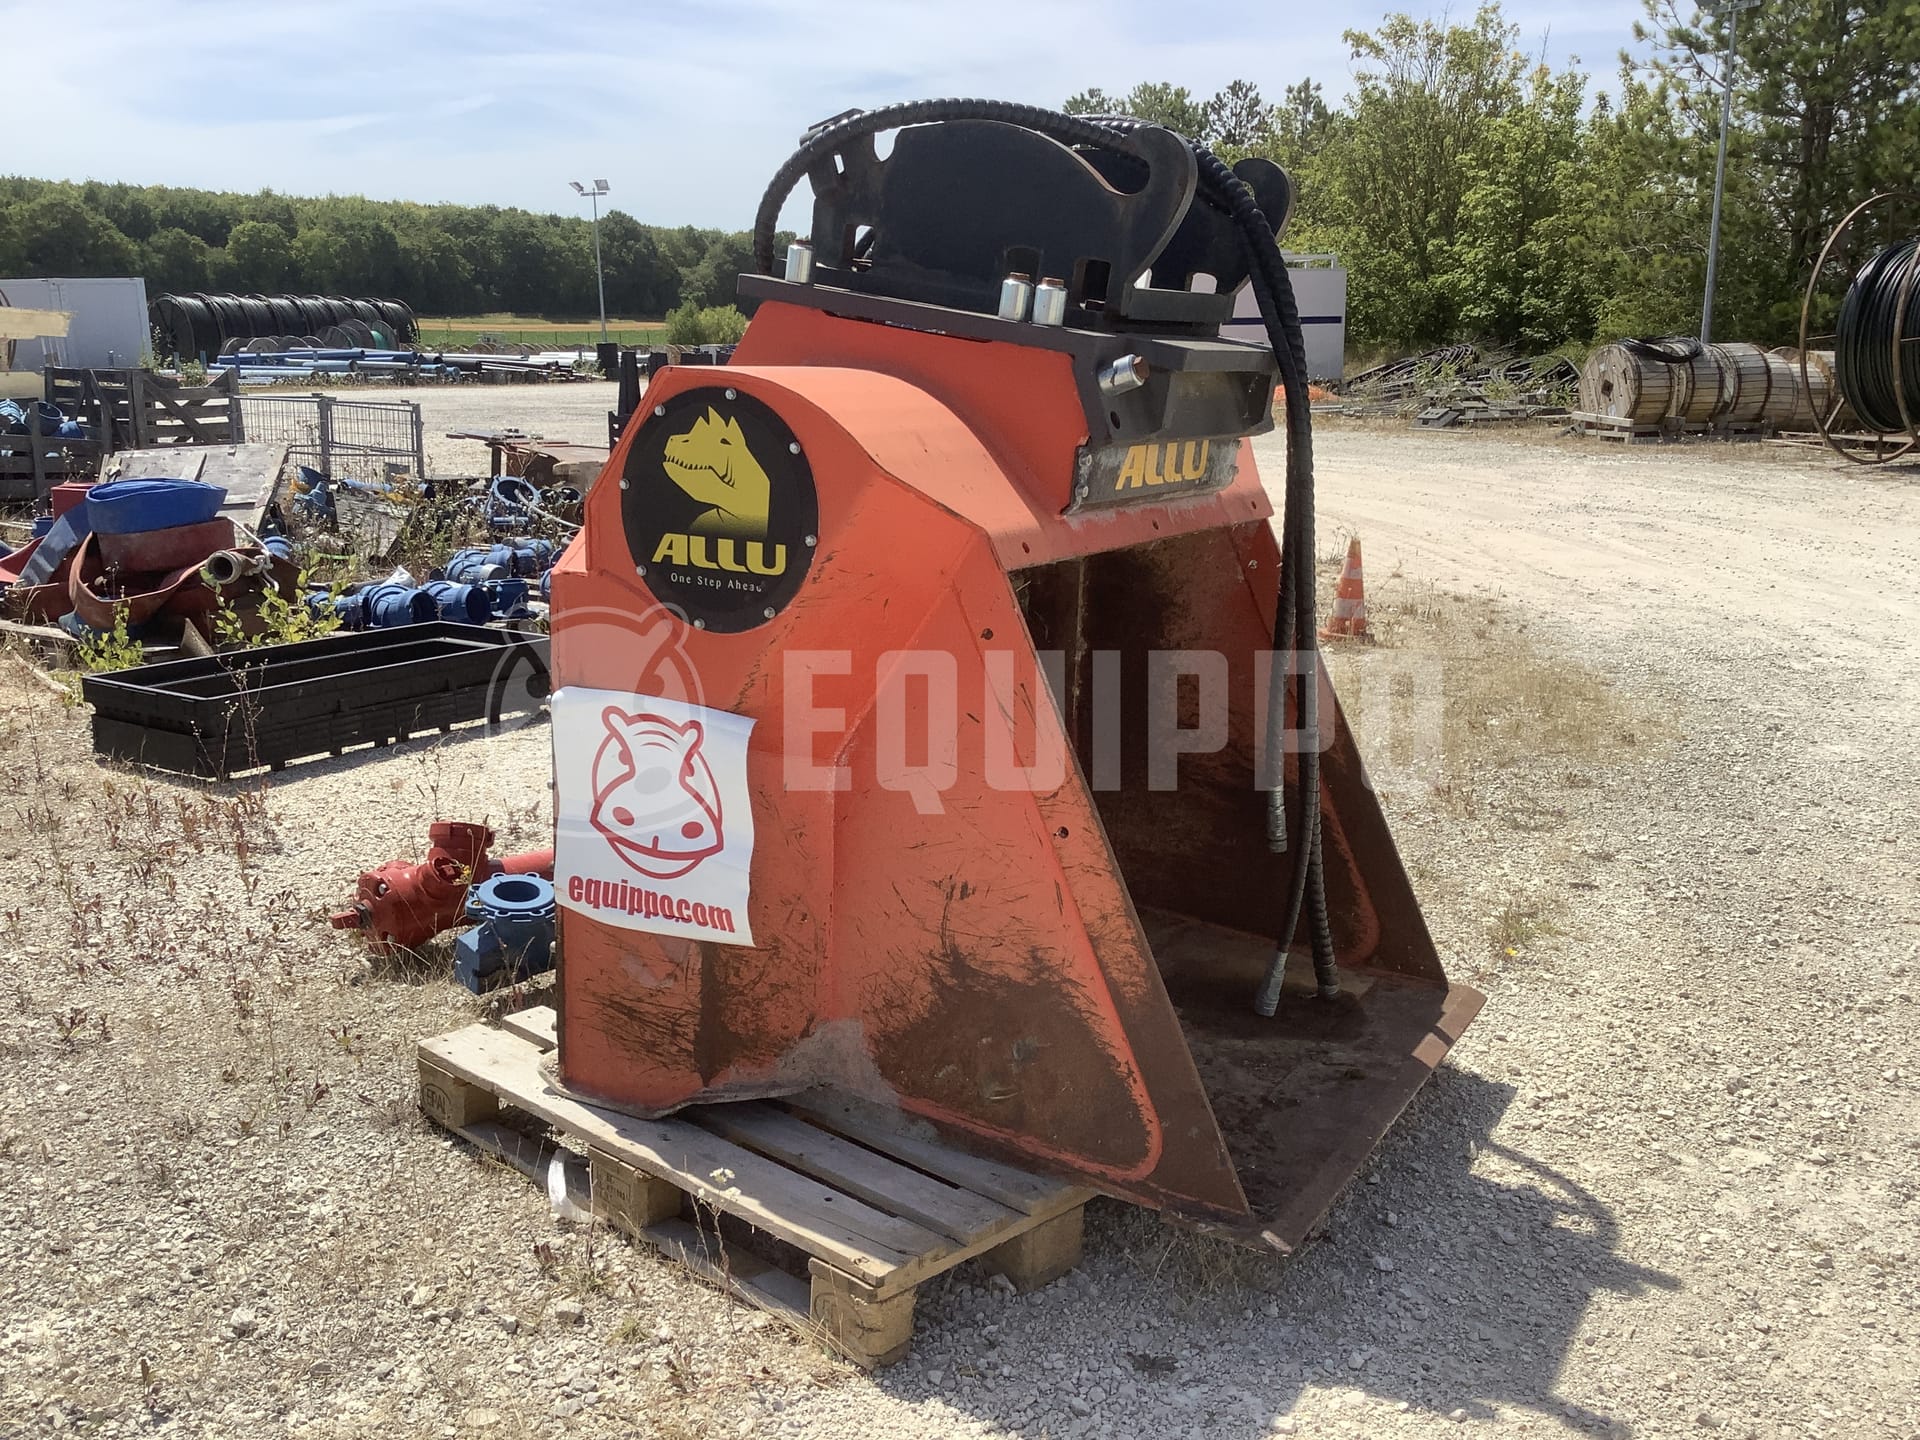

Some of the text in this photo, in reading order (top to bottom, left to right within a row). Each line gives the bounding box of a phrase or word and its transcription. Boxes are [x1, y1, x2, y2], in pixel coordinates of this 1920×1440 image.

[1115, 440, 1210, 490] ALLU
[652, 533, 787, 576] ALLU
[670, 572, 692, 584] One
[697, 575, 722, 590] Step
[568, 875, 736, 933] equippo.com
